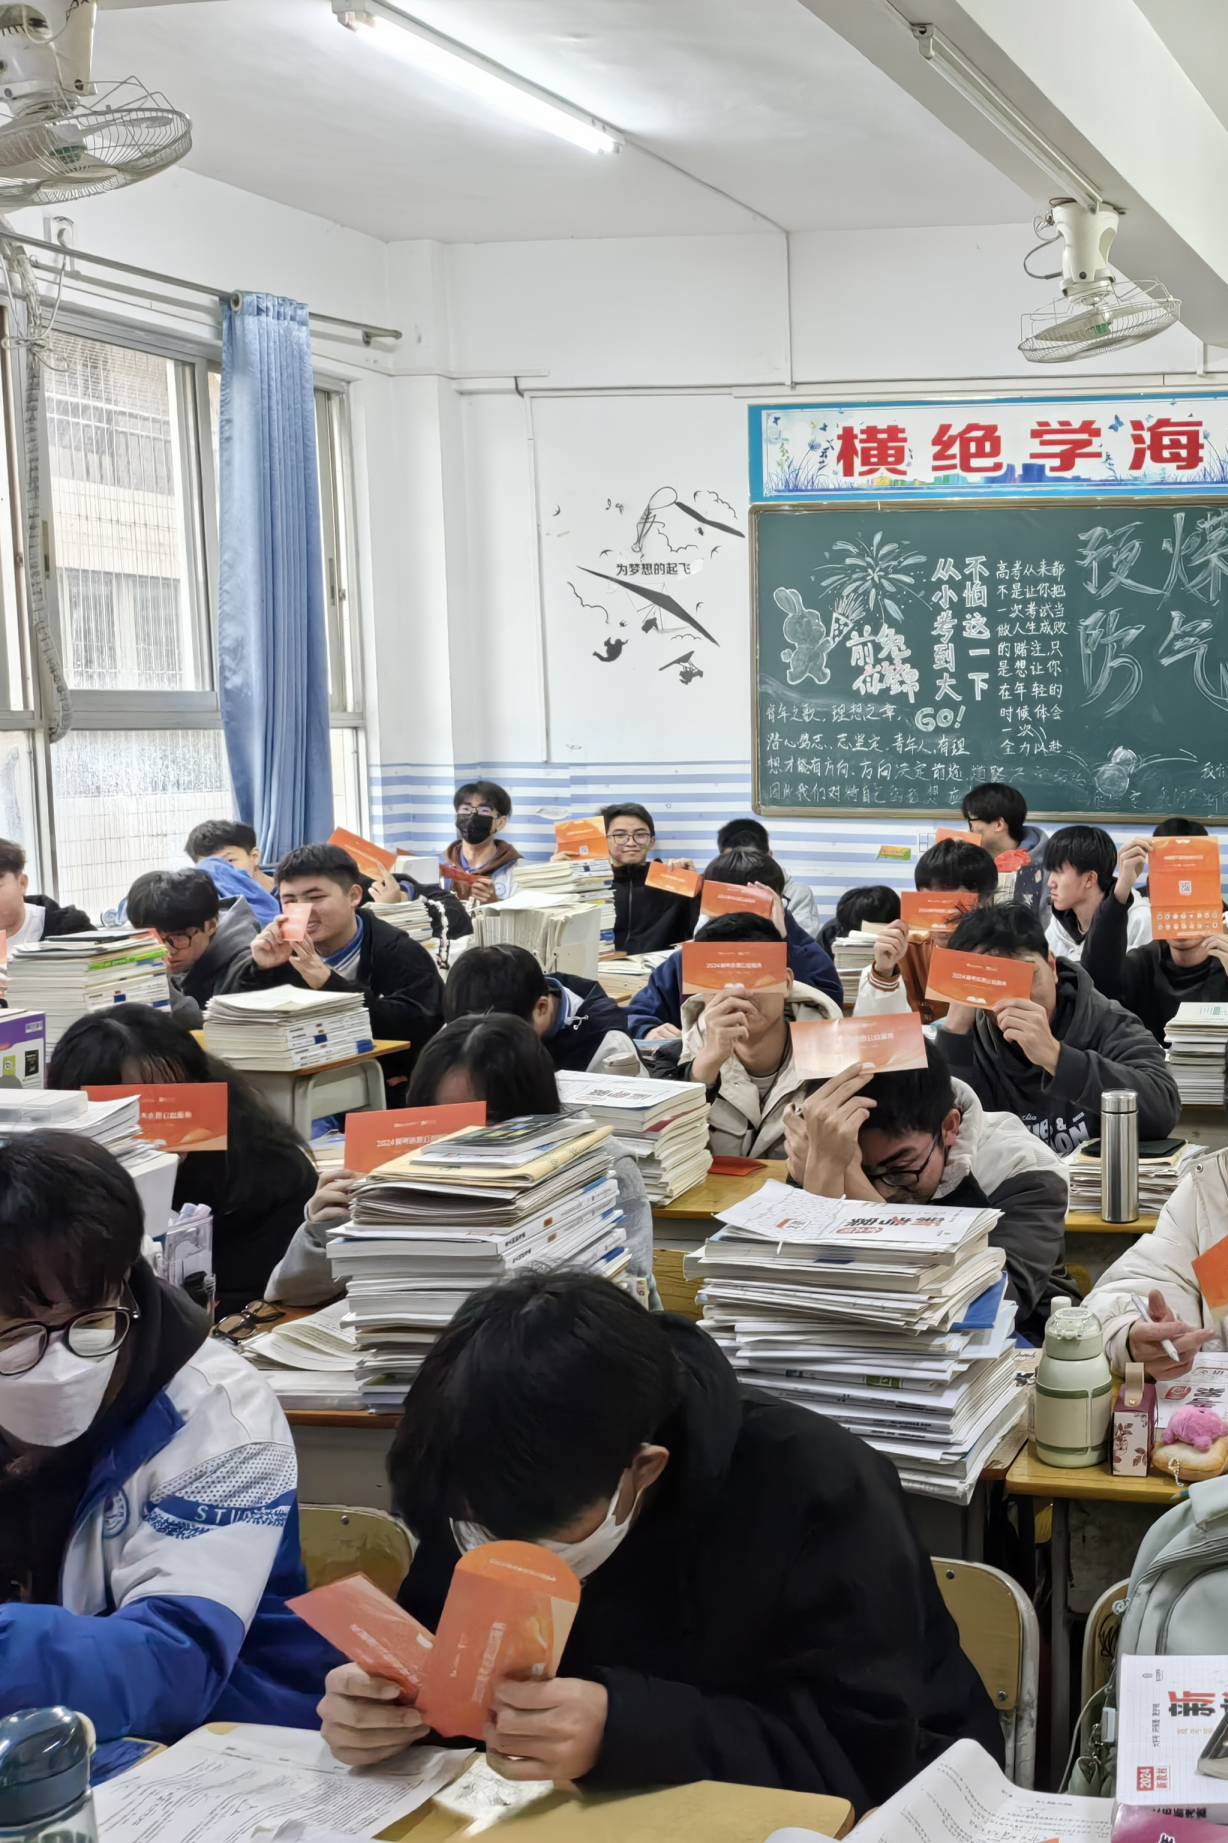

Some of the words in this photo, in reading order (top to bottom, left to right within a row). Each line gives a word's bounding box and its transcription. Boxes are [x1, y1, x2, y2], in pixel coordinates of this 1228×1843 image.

[836, 417, 1205, 478] 横绝学海
[615, 562, 692, 577] 为梦想的起飞
[996, 559, 1067, 581] 高考从来都
[997, 582, 1067, 600] 不是让你把
[997, 601, 1066, 619] 一次考试当
[931, 557, 963, 701] 从小考到大
[962, 555, 991, 701] 不怕这一下
[995, 621, 1069, 637] 做人生成败
[998, 659, 1063, 678] 是想让你
[998, 681, 1063, 702] 在年轻的
[914, 705, 966, 732] GO!
[1000, 704, 1064, 723] 时候体会
[1001, 724, 1035, 737] 一次
[1000, 738, 1064, 756] 全力以赴
[1140, 1767, 1152, 1789] 2024
